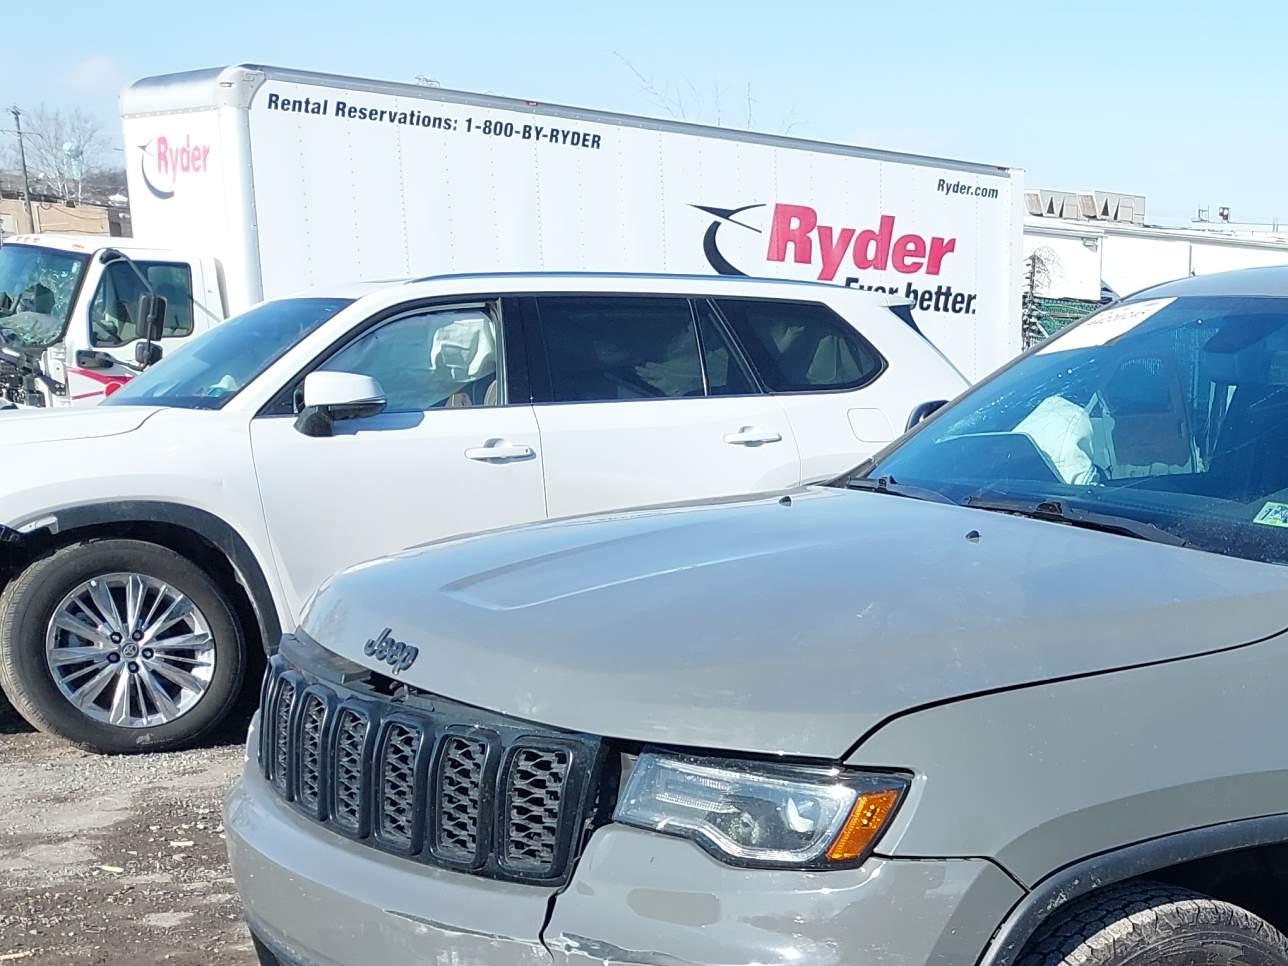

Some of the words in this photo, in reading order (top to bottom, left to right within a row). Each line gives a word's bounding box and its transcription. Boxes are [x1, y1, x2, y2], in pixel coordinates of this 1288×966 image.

[267, 93, 329, 115] Rental
[335, 101, 458, 131] Reservations:
[464, 117, 601, 150] 1-800-BY-RYDER
[157, 133, 210, 185] Ryder
[937, 178, 999, 199] Ryder.com
[766, 203, 957, 281] Ryder
[905, 282, 977, 315] better.
[363, 627, 419, 676] Jeep
